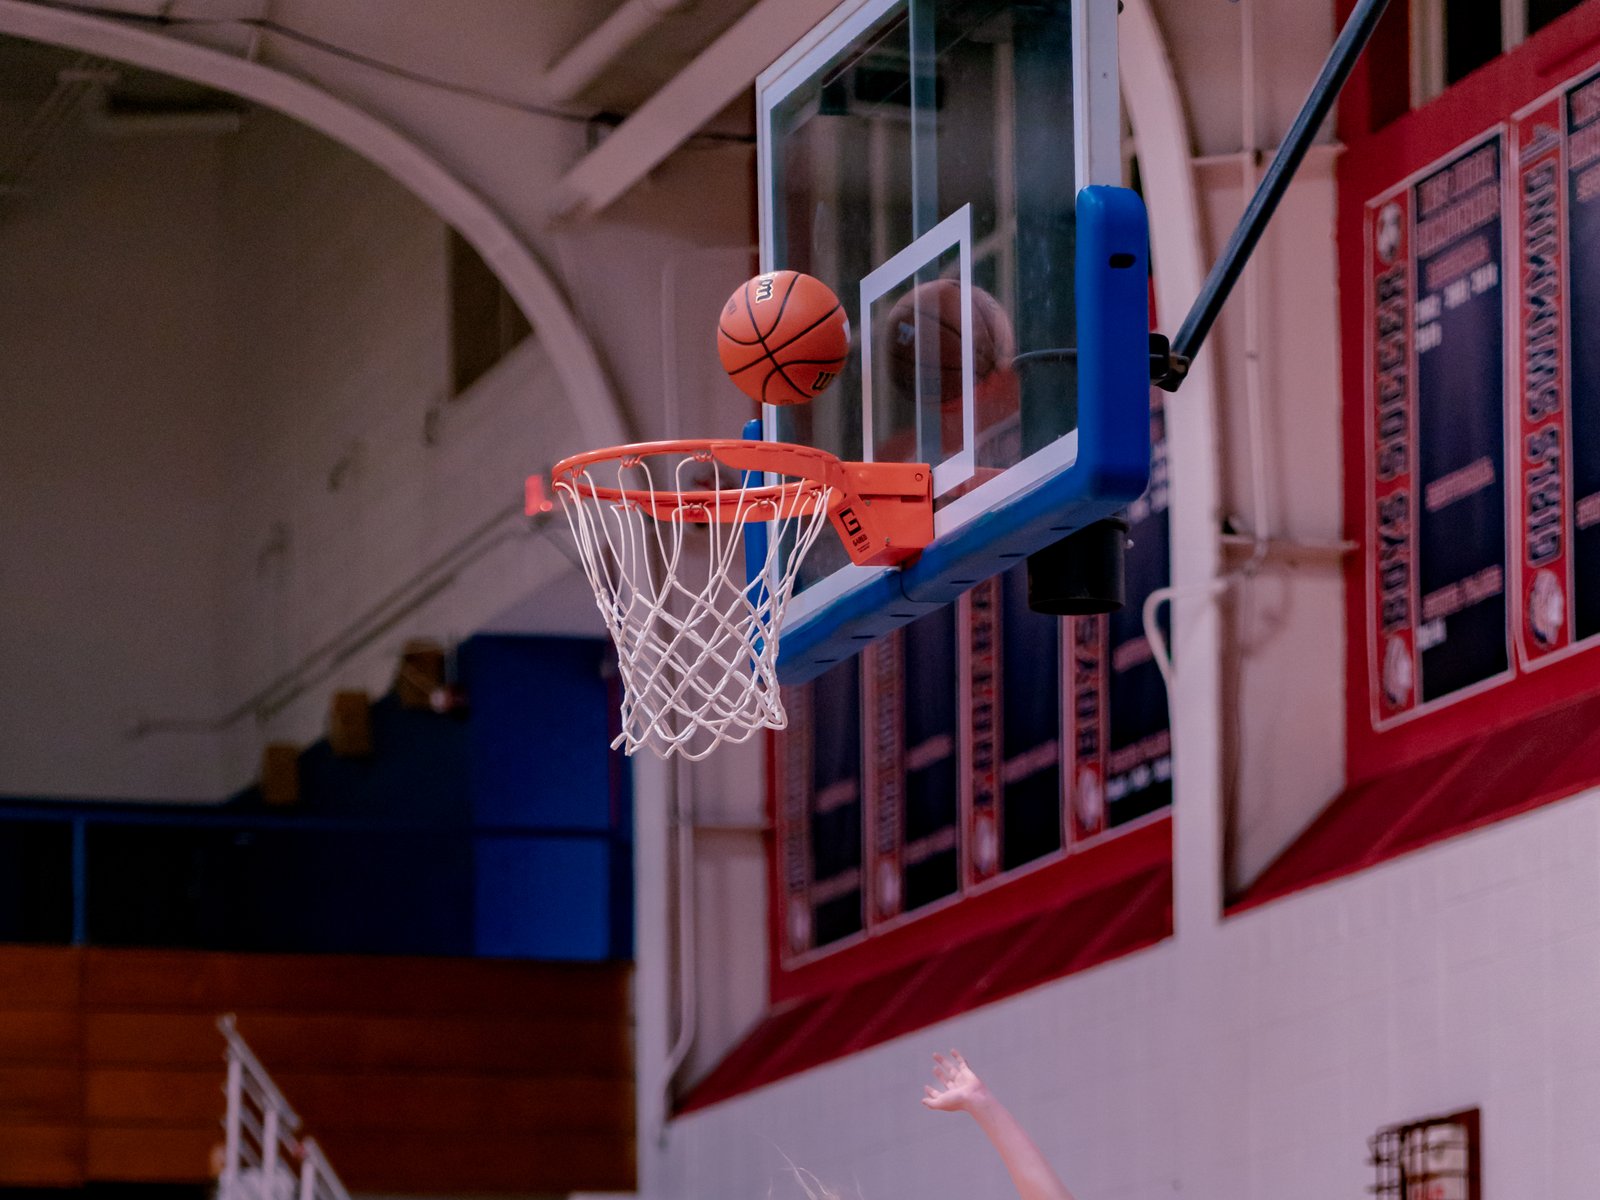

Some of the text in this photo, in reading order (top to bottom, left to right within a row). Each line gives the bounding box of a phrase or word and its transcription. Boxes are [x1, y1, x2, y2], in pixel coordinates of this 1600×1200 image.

[1376, 262, 1410, 637] BOYS SOCCER
[1521, 156, 1562, 568] GIRLS SWIMMING
